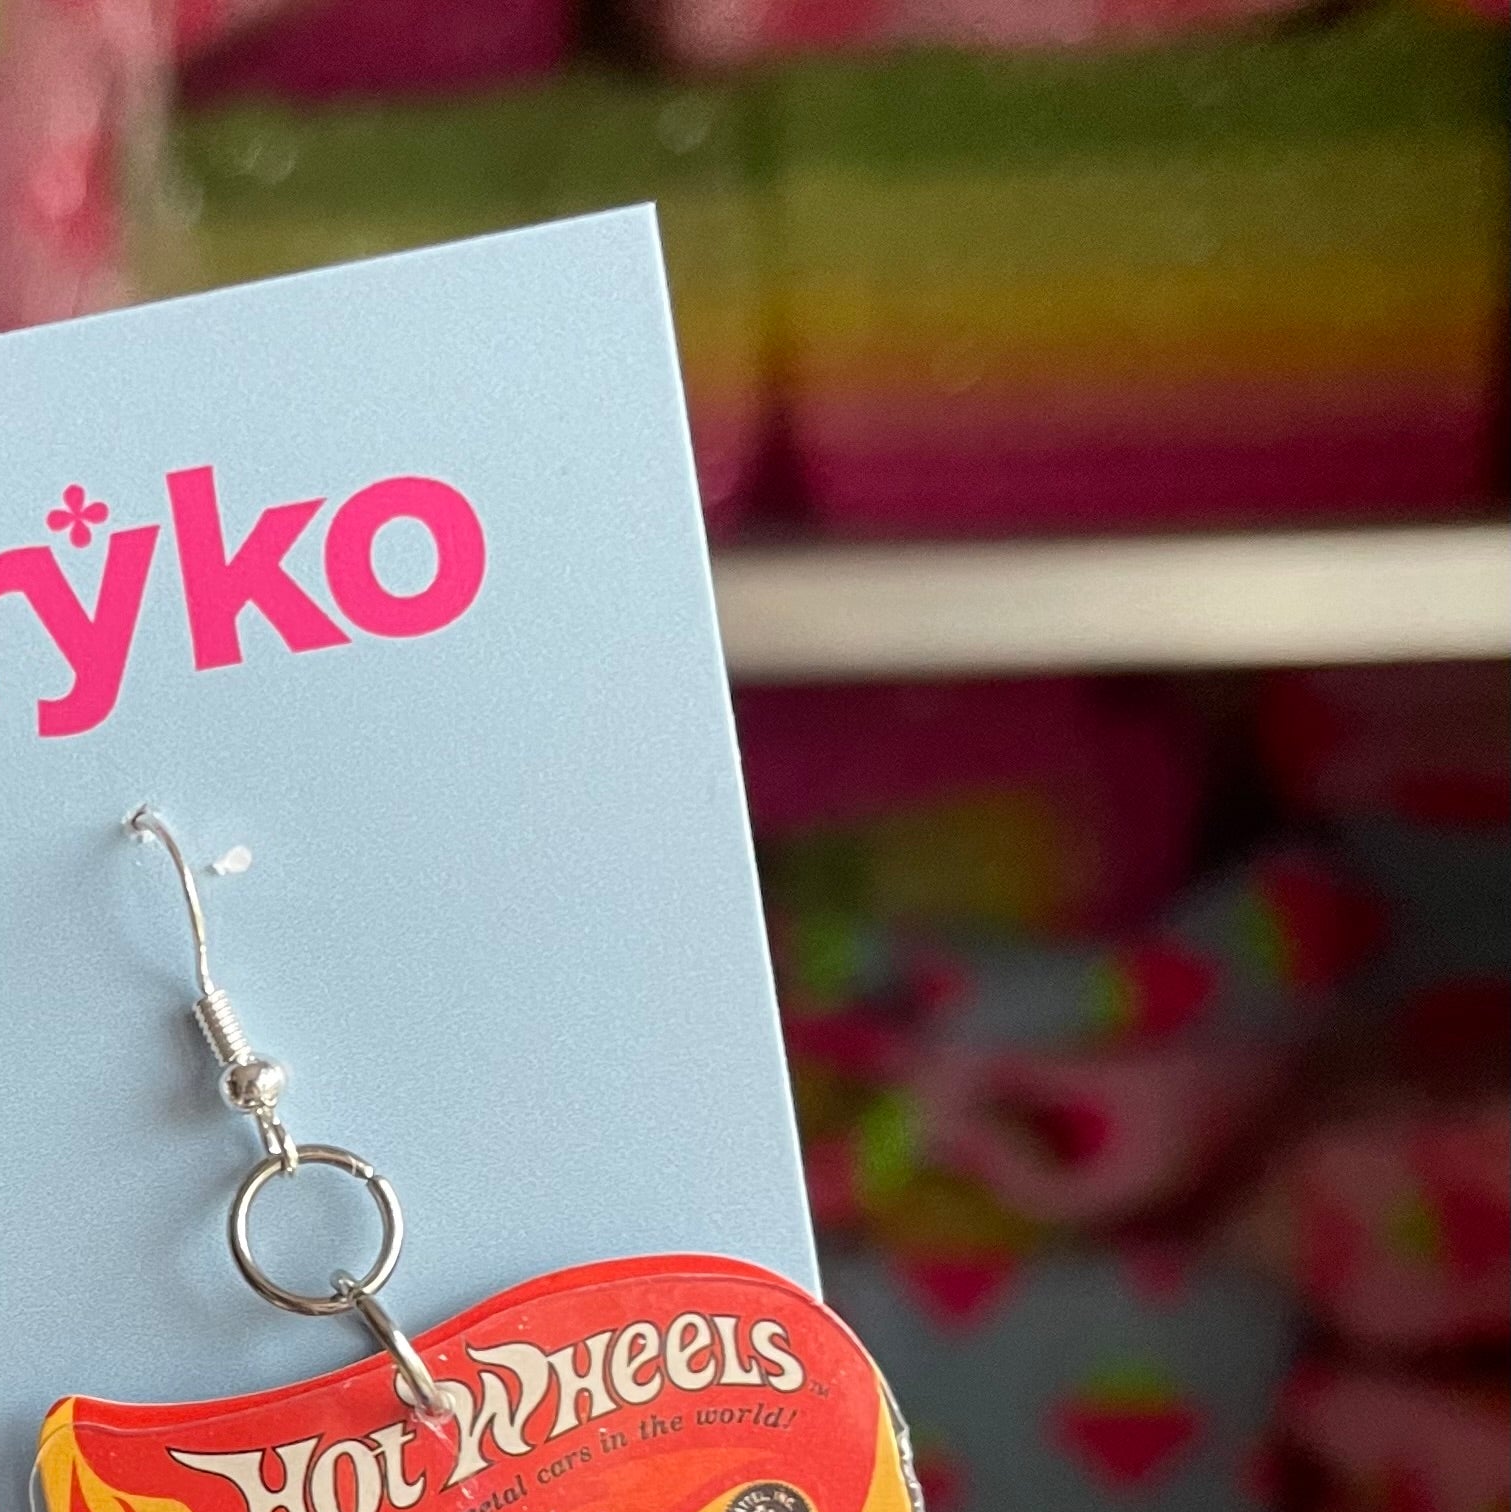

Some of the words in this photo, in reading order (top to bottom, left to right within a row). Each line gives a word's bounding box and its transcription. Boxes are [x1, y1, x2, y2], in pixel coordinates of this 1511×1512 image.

[538, 1444, 592, 1485] cars
[600, 1429, 628, 1454] in
[640, 1414, 683, 1441] the
[696, 1402, 798, 1430] world!
